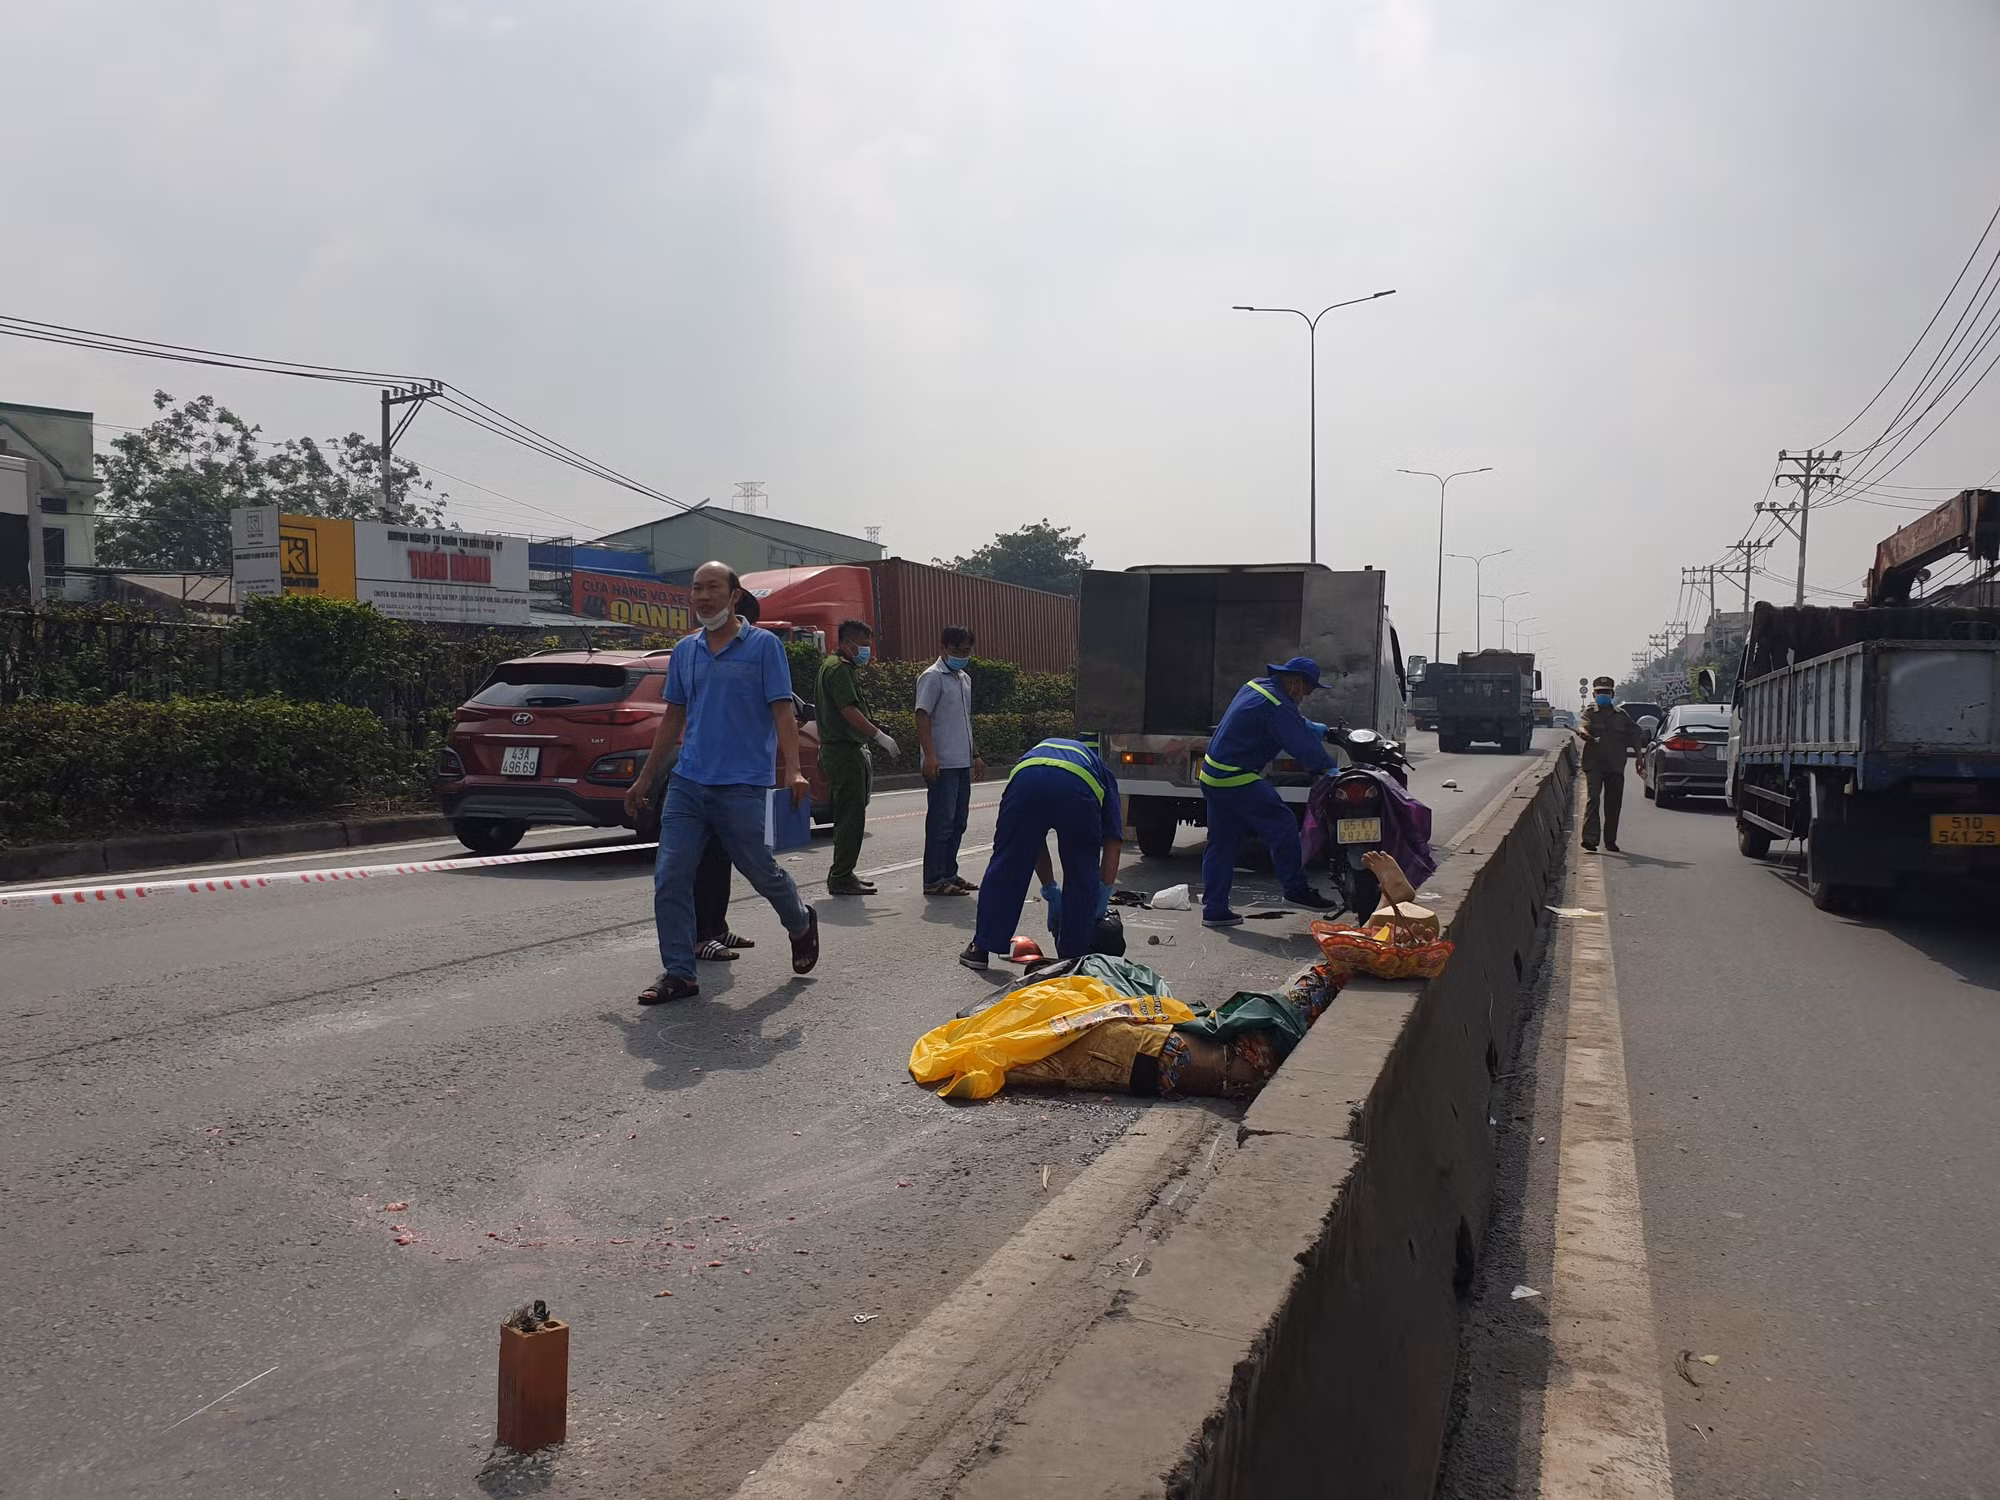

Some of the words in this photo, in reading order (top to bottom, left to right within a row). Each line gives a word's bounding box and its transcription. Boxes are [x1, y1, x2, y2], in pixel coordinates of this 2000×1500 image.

[613, 581, 647, 599] HÀNG
[610, 599, 690, 631] OANH
[511, 747, 530, 761] 43A
[502, 761, 536, 774] 496.69
[1951, 816, 1984, 830] 51D
[1938, 830, 1996, 844] 541.25
